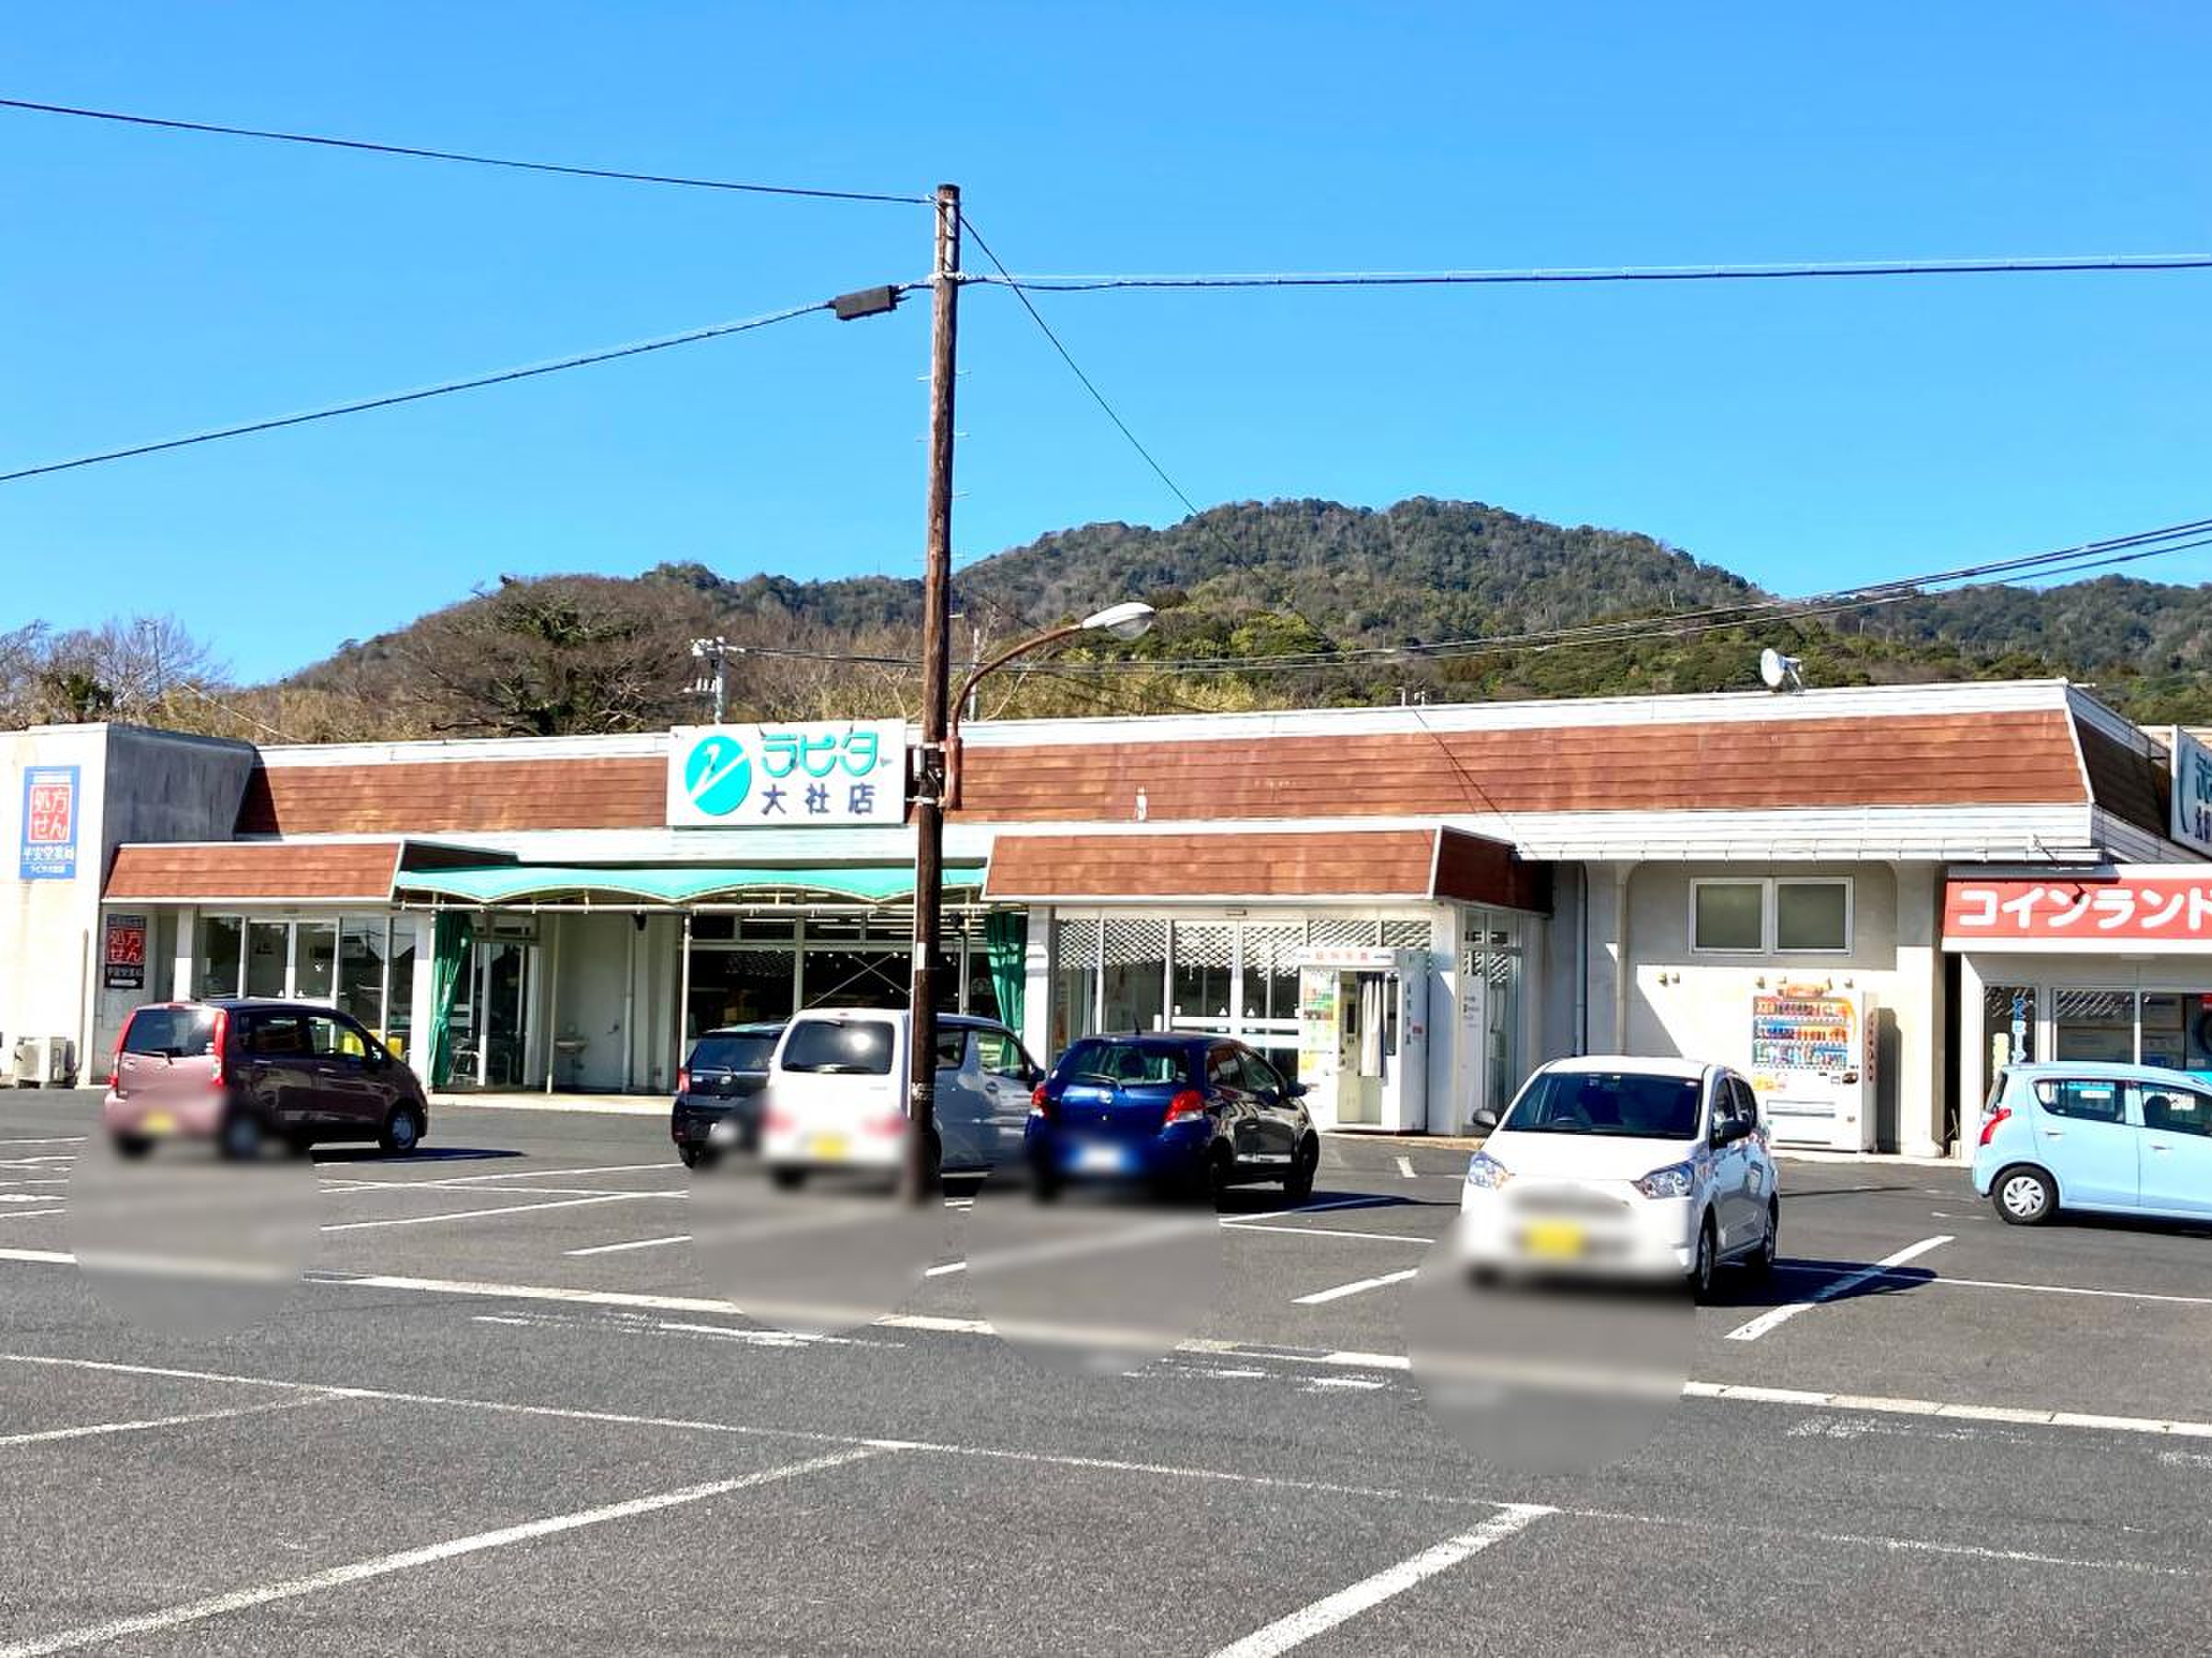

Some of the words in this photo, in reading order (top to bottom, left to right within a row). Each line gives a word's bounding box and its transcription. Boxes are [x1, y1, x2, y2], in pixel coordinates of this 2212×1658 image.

[762, 732, 879, 777] ラピタ
[33, 788, 69, 811] 処方
[761, 783, 876, 816] 大社店
[31, 811, 68, 840] せん
[110, 928, 142, 948] 処方
[110, 949, 143, 963] せん
